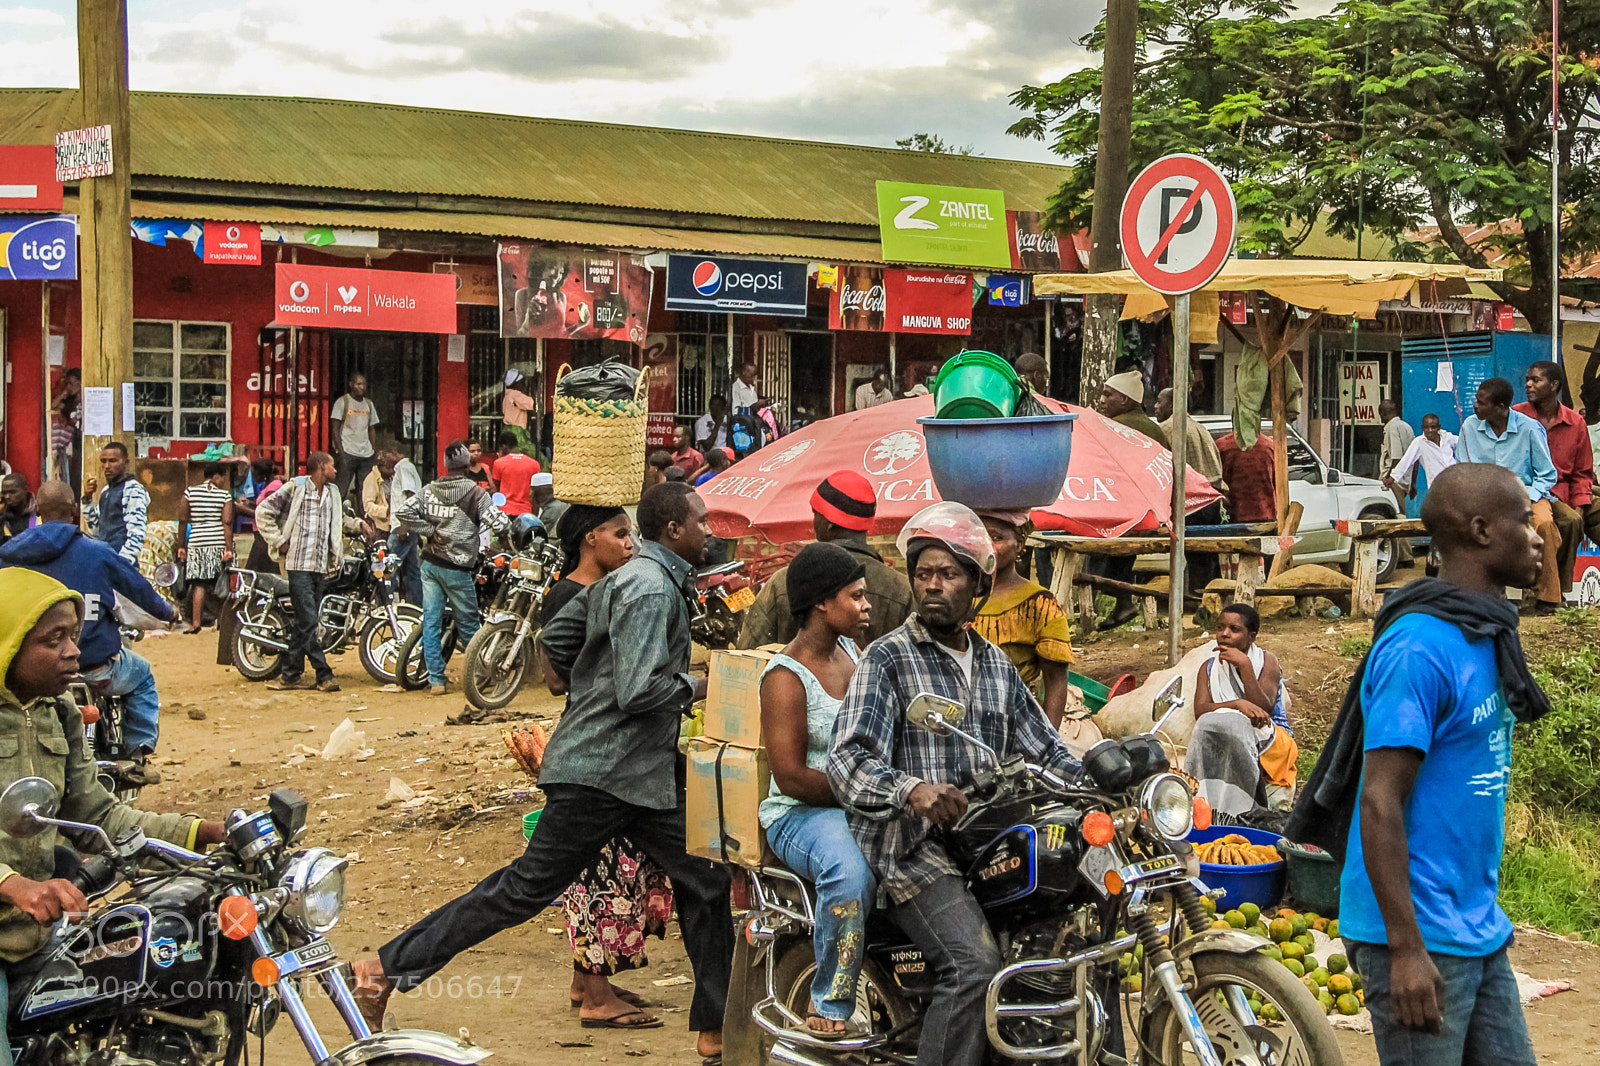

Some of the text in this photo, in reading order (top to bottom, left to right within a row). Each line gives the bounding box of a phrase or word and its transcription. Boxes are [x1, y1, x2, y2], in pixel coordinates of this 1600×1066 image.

[939, 200, 995, 221] ZANTEL
[22, 238, 66, 262] tigo
[725, 270, 783, 293] pepsi
[279, 303, 320, 314] vodacom
[374, 294, 416, 309] Wakala
[840, 284, 886, 312] Coca-Cola
[902, 315, 943, 329] MANGUVA
[947, 317, 971, 330] SHOP
[246, 365, 317, 392] airtel
[1343, 365, 1374, 380] DUKA
[1344, 405, 1375, 420] DAWA
[705, 476, 774, 500] FINCA
[1146, 858, 1174, 870] TOYO
[301, 944, 330, 960] TOYO
